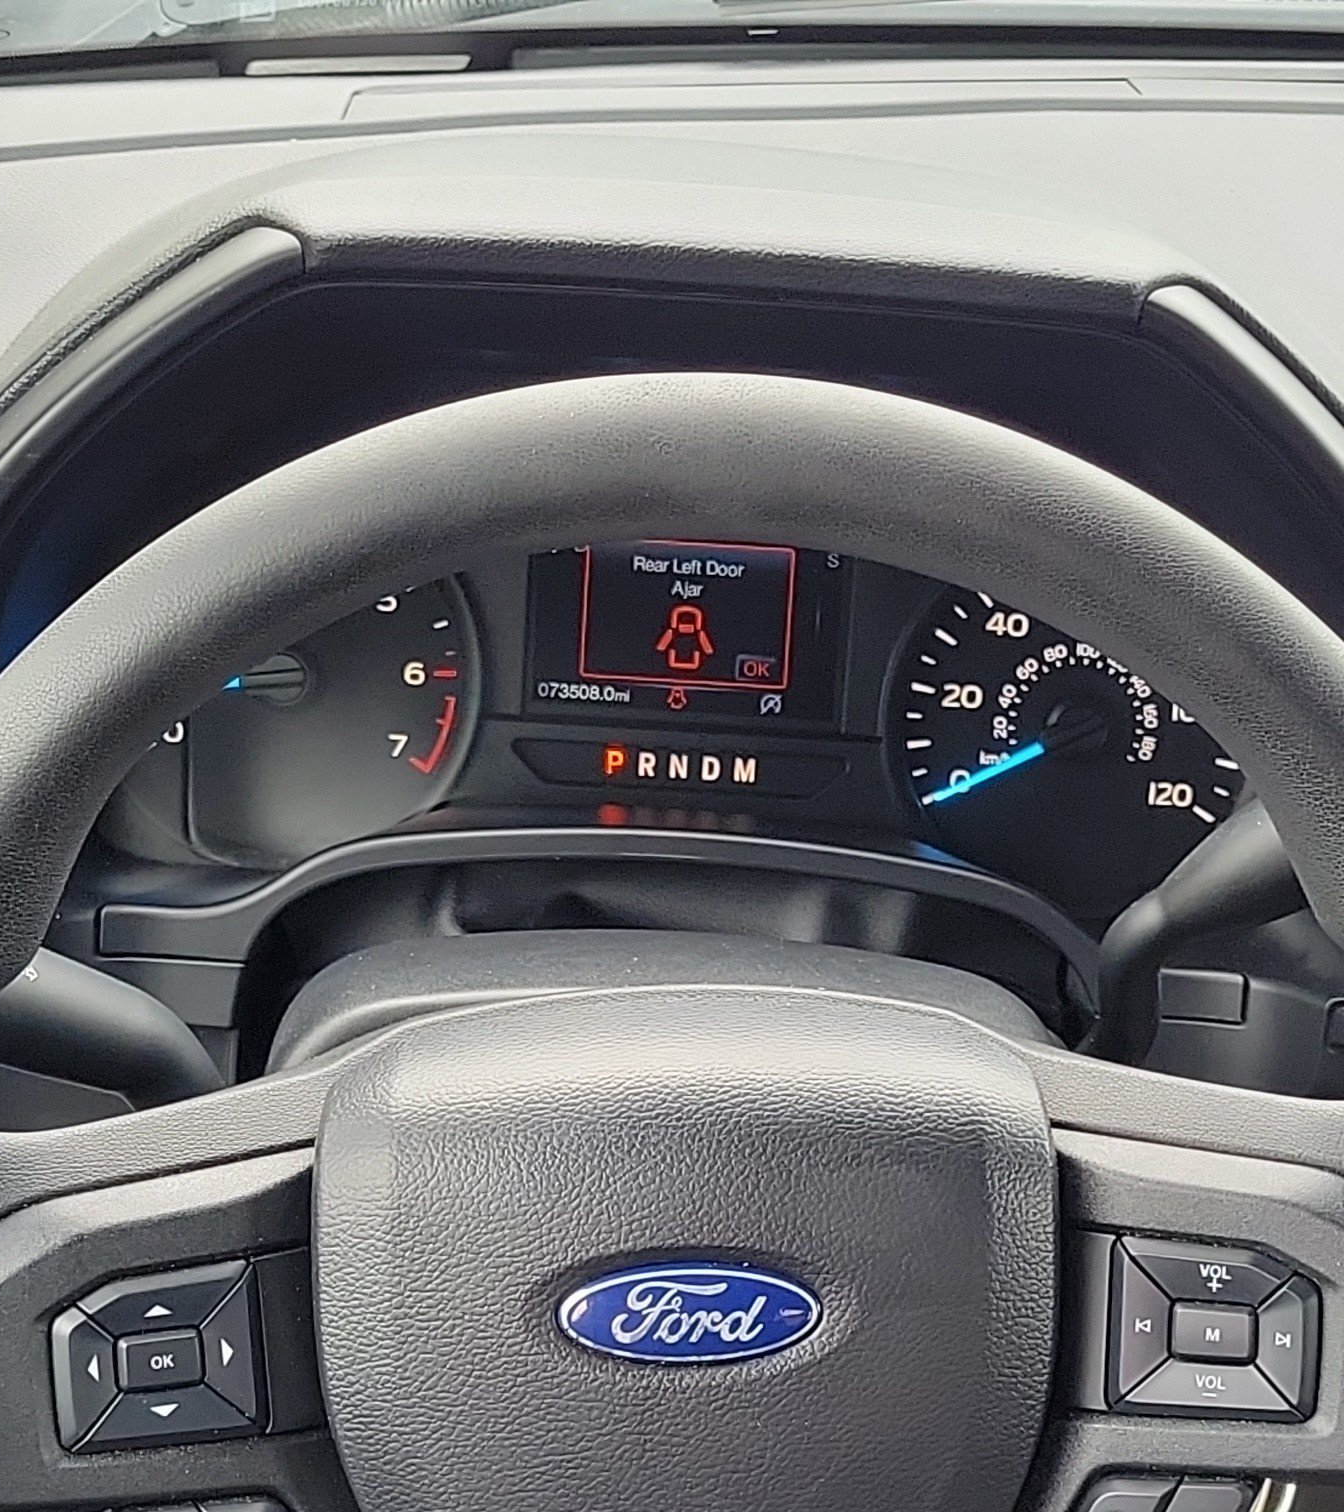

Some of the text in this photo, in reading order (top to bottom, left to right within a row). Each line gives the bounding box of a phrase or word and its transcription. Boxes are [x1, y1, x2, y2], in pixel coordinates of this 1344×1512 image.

[632, 555, 746, 578] Rear Left Door
[827, 553, 840, 569] S
[670, 580, 704, 599] Ajar
[985, 611, 1030, 638] 40
[1042, 643, 1069, 663] 80
[404, 661, 427, 687] 6
[743, 661, 770, 677] OK
[1015, 657, 1039, 681] 60
[537, 682, 631, 703] 073508.0mi
[940, 683, 984, 709] 20
[997, 683, 1018, 709] 40
[992, 715, 1009, 740] 20
[387, 733, 409, 759] 7
[607, 750, 757, 784] P R N D M
[1147, 780, 1194, 808] 120
[1199, 1263, 1232, 1281] VOL
[611, 1280, 768, 1345] Ford
[1205, 1328, 1221, 1343] M
[150, 1352, 175, 1370] OK
[1194, 1374, 1226, 1391] VOL
